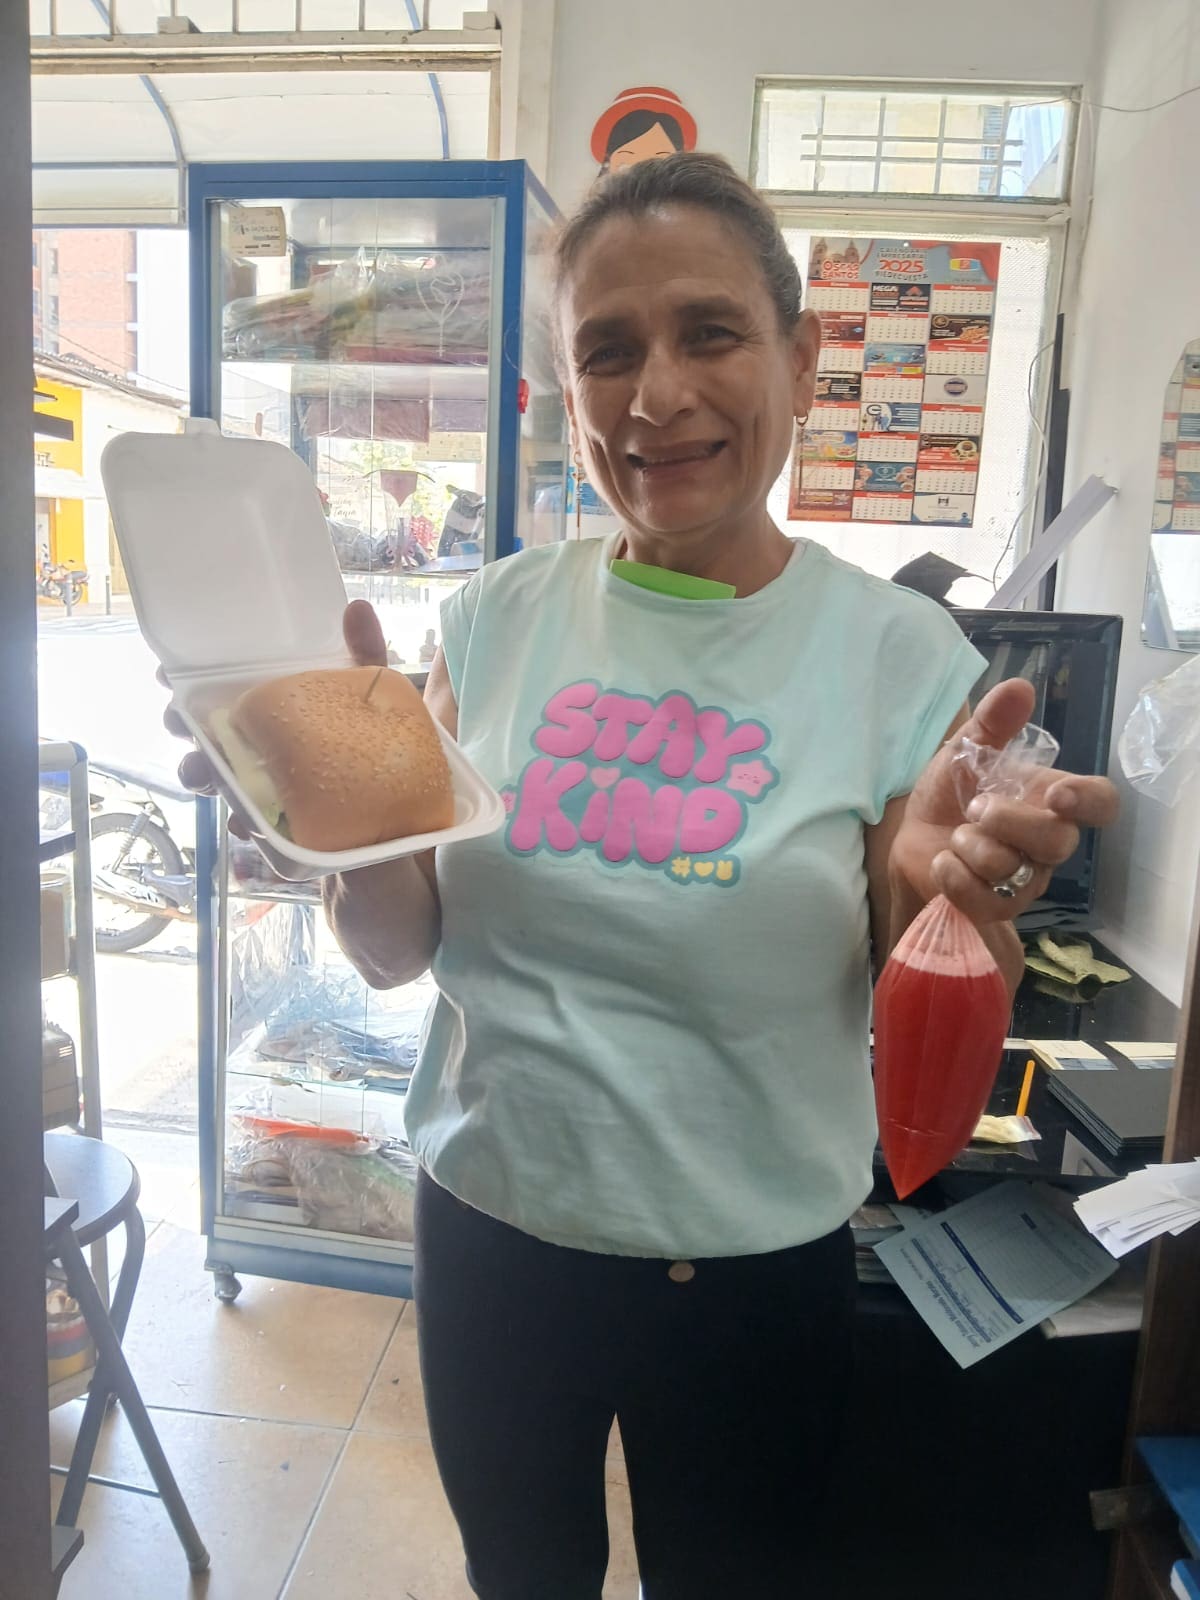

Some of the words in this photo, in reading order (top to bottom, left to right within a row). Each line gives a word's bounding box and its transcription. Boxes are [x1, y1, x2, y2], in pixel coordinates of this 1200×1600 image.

[879, 259, 924, 273] 2025
[822, 271, 860, 280] SANTOS
[535, 682, 766, 784] STAY
